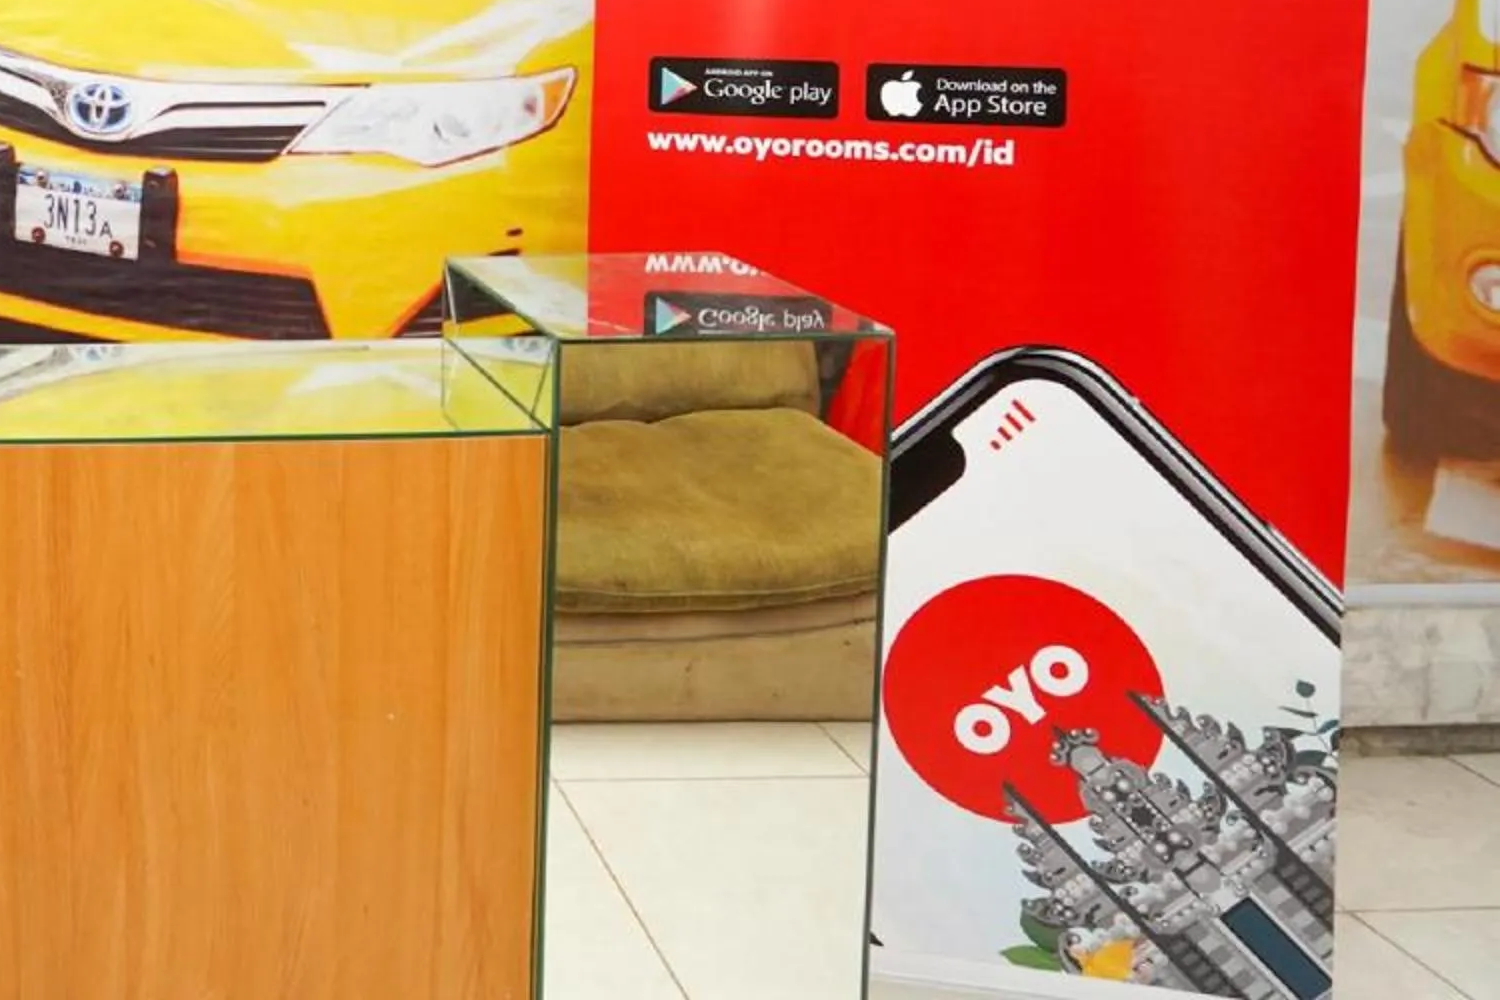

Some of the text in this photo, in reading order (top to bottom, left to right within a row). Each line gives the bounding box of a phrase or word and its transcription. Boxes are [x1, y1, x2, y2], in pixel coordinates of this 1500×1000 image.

[743, 69, 759, 77] APP
[703, 78, 833, 106] Google play
[936, 78, 1057, 95] Download on the
[933, 94, 1048, 117] App Store
[647, 132, 1016, 167] www.oyorooms.com/id
[954, 645, 1089, 755] OYO
